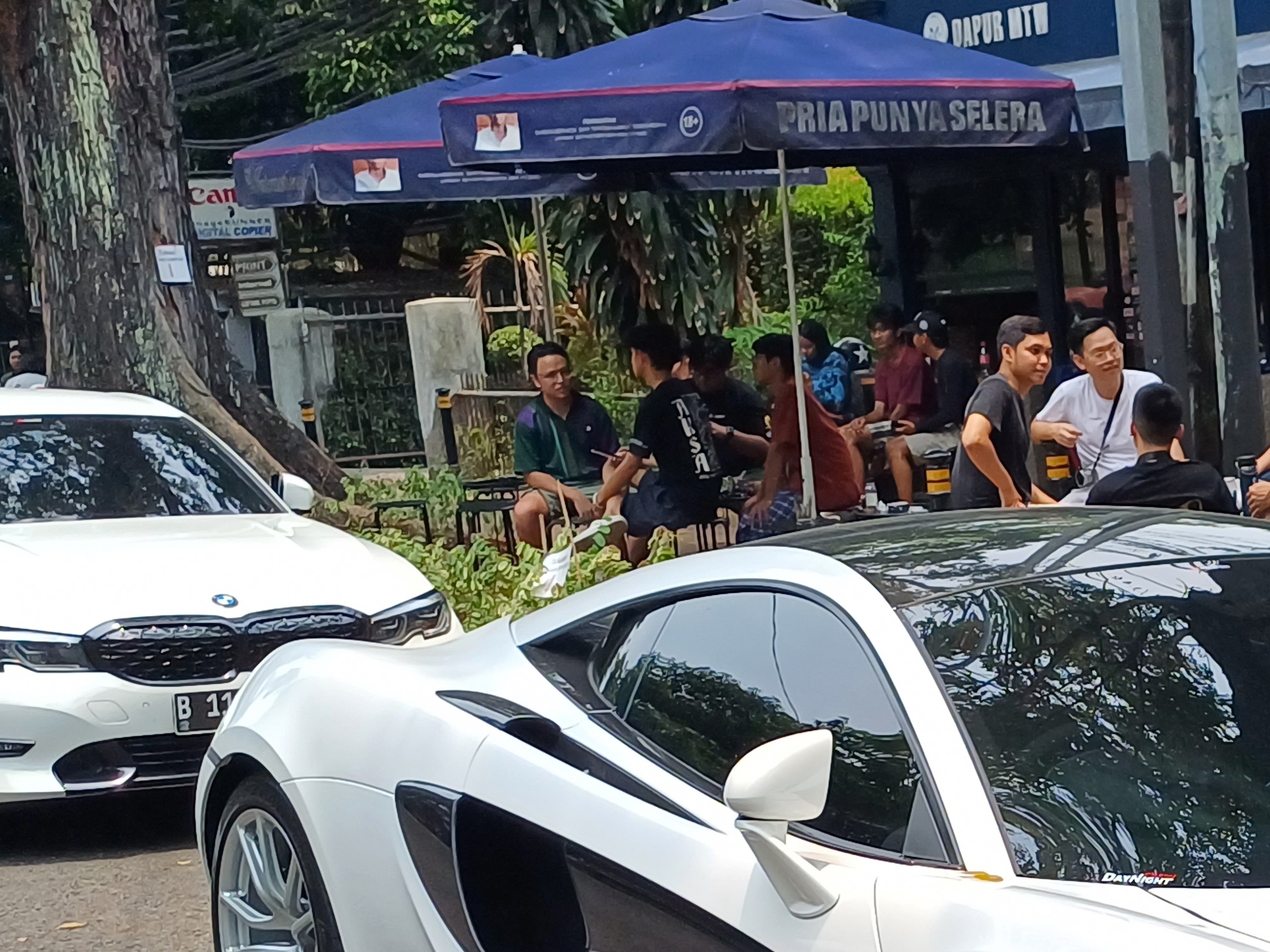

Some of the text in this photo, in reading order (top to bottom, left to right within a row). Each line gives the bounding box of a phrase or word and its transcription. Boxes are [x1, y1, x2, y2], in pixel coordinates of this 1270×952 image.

[951, 10, 1005, 48] DAPUR
[776, 100, 1047, 133] PRIA PUNYA SELERA
[234, 226, 272, 236] COPIER
[177, 696, 192, 720] B
